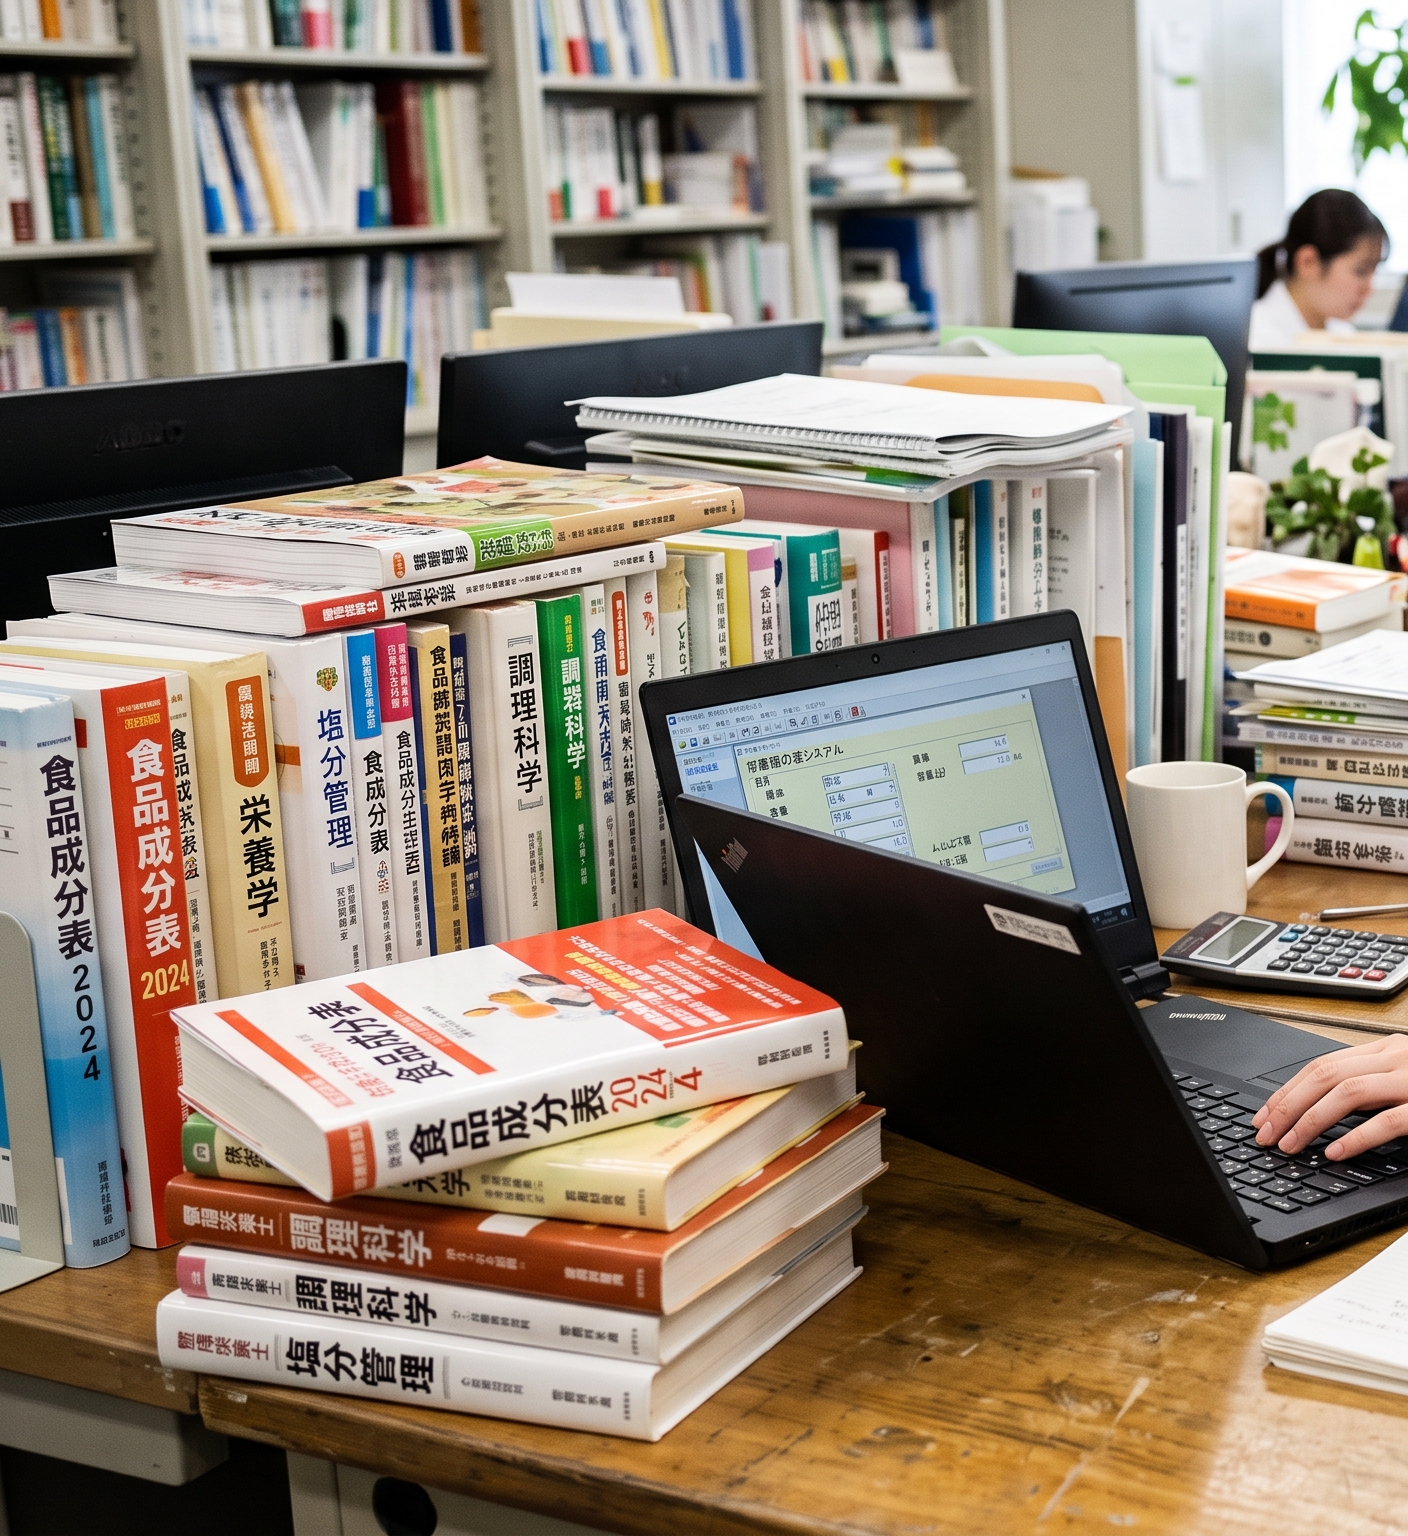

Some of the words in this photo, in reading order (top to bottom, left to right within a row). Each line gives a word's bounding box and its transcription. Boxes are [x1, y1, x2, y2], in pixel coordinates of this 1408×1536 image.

[127, 738, 182, 958] 食品成分表
[238, 794, 280, 919] 栄養学
[140, 958, 191, 1000] 2024
[307, 1000, 455, 1084] 食品成分表
[408, 1080, 610, 1164] 食品成分表
[288, 1212, 433, 1268] 調理科学
[285, 1335, 435, 1394] 塩分管理
